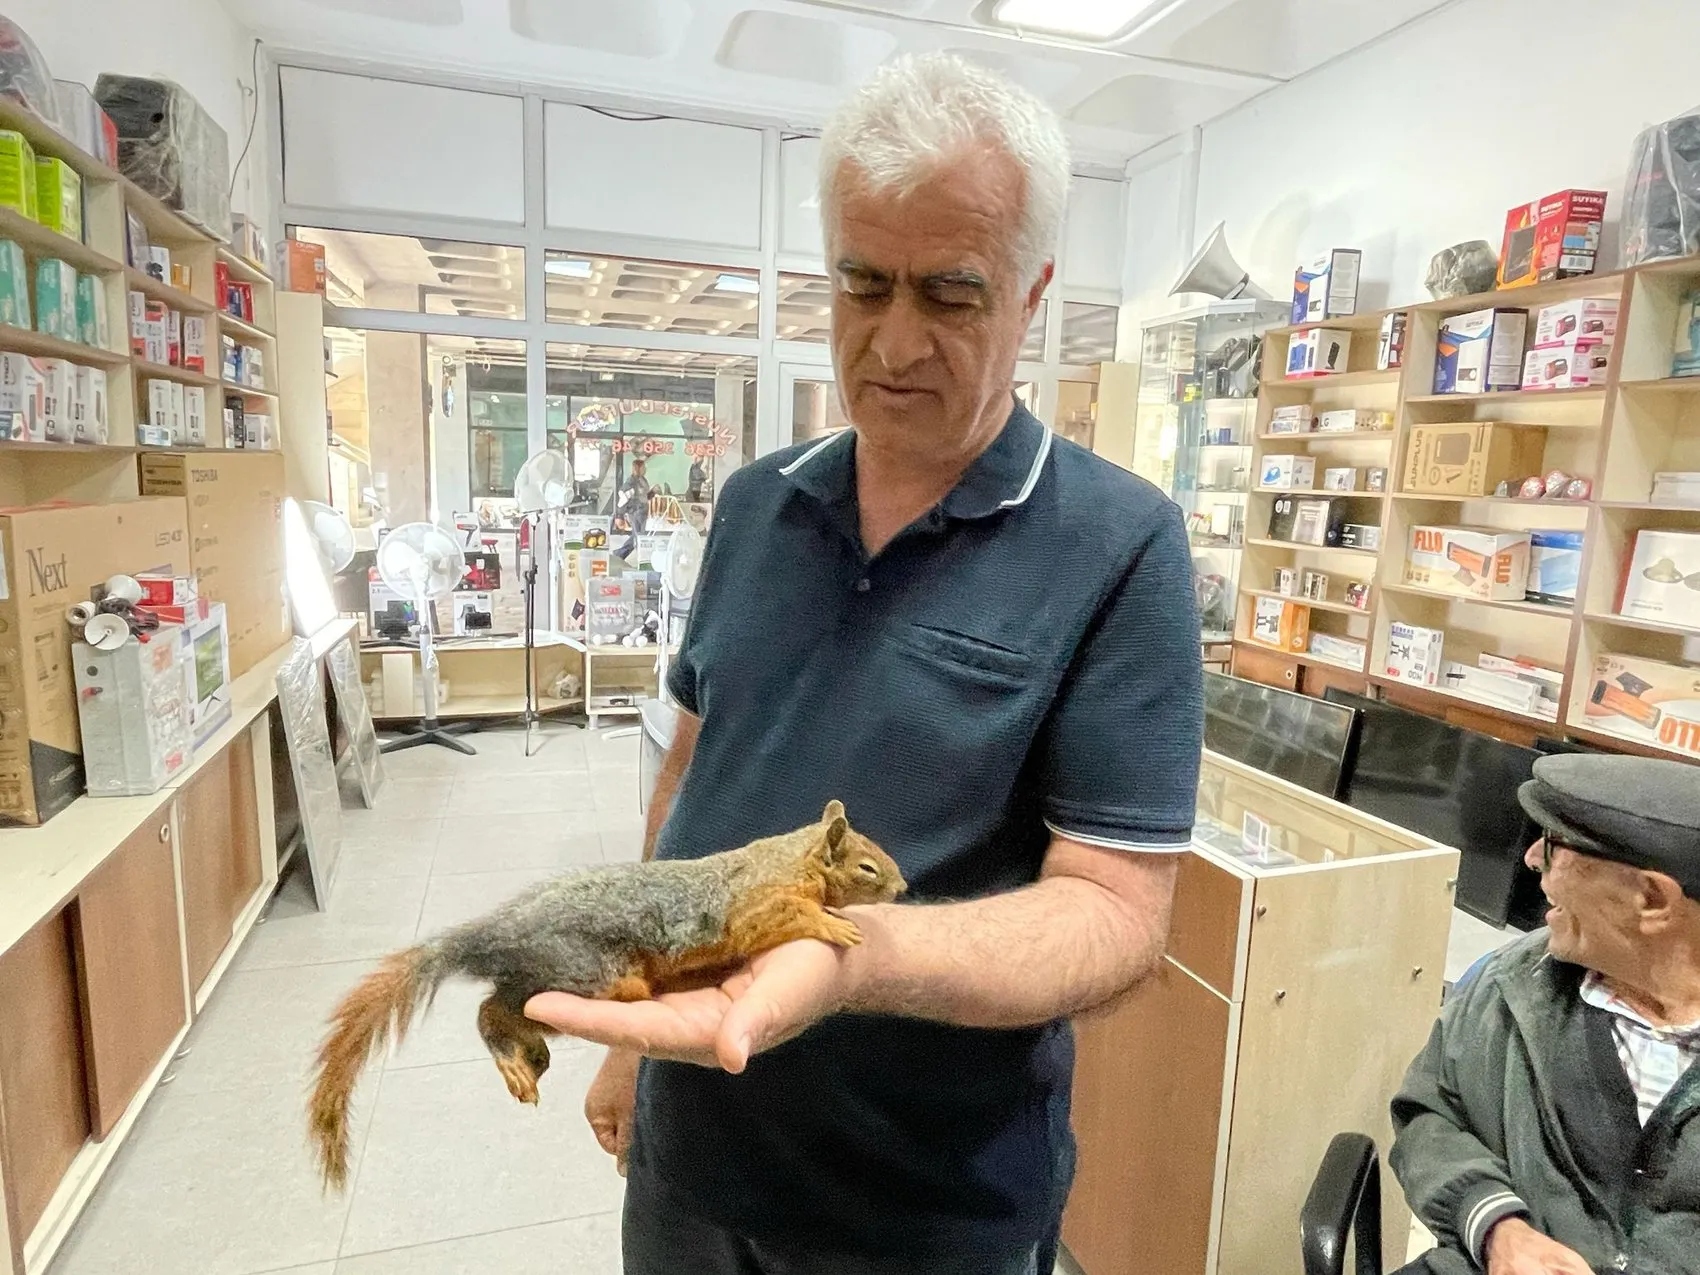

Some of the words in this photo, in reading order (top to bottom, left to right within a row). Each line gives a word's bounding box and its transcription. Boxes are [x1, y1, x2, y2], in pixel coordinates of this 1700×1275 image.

[1319, 417, 1330, 427] LG
[191, 469, 218, 483] TOSHIBA
[25, 547, 69, 597] Next
